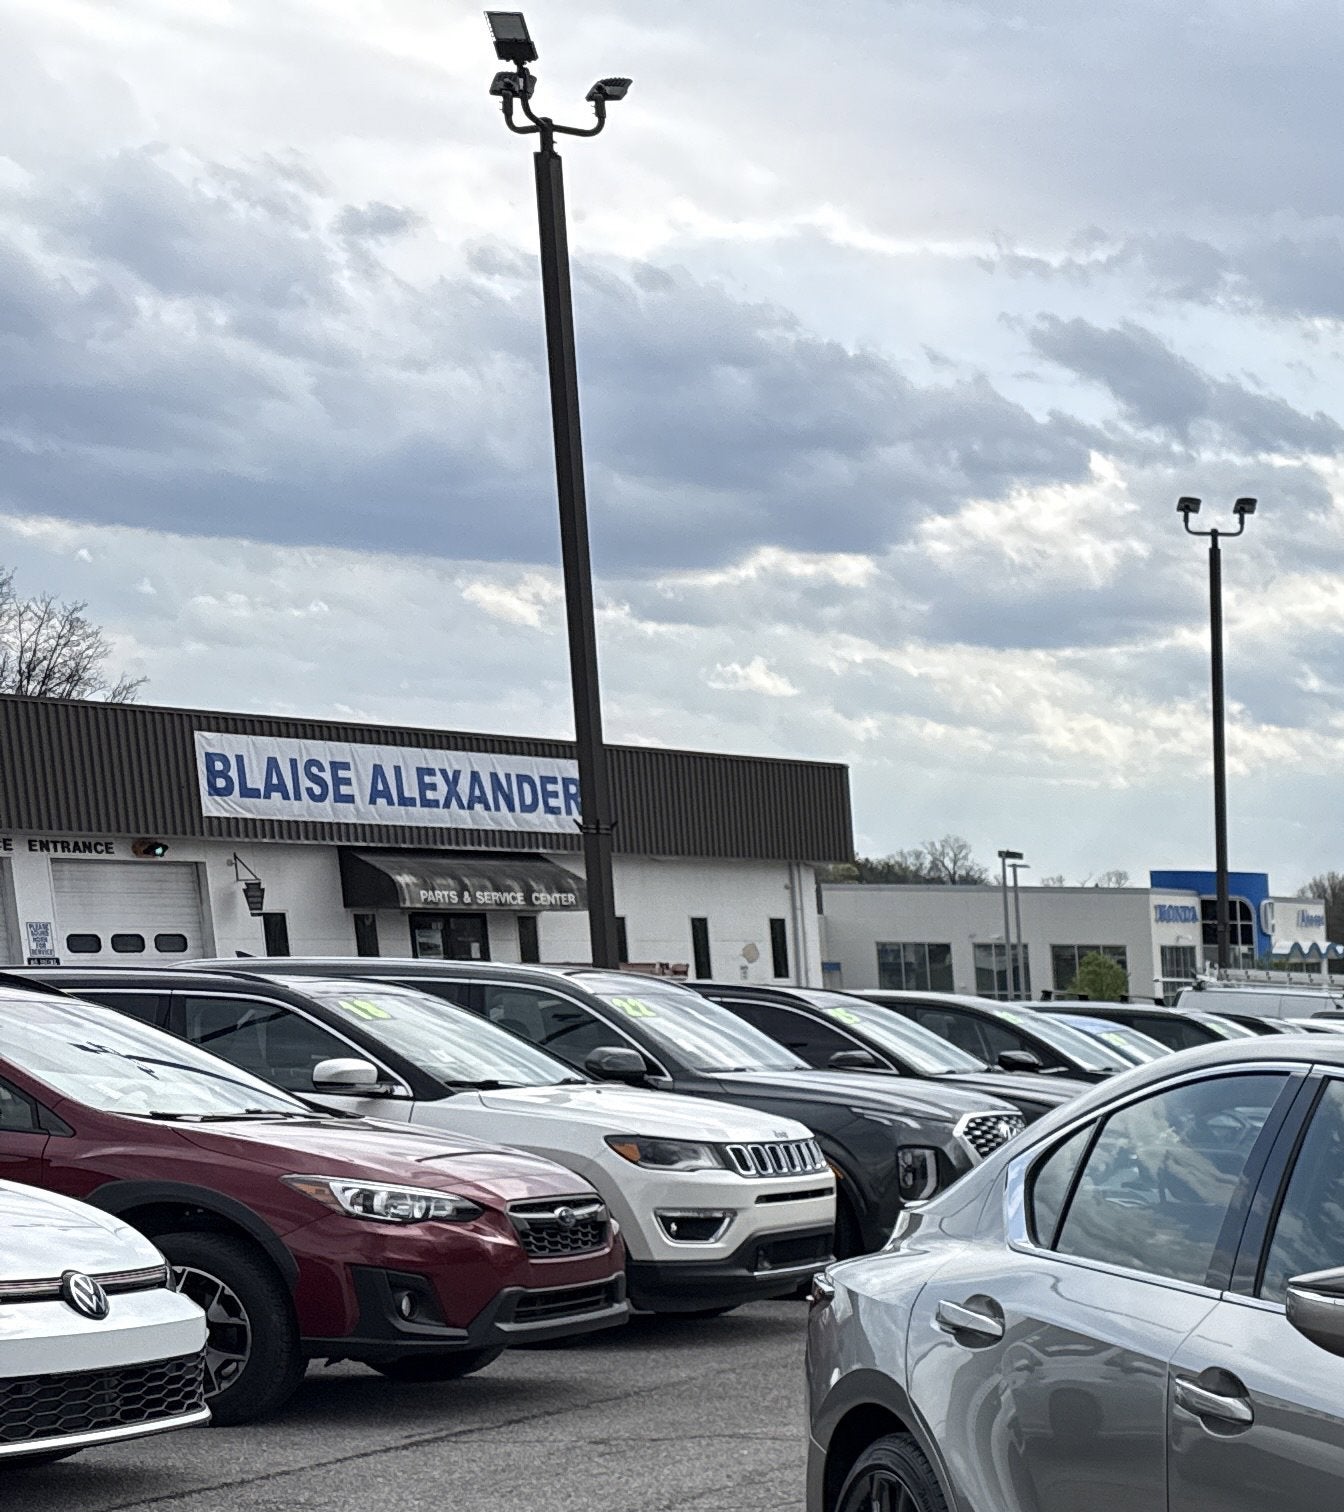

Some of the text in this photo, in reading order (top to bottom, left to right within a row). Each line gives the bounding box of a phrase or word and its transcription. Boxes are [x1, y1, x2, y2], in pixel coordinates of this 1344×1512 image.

[204, 751, 583, 818] BLAISE ALEXANDER
[27, 839, 115, 855] ENTRANCE
[420, 890, 577, 906] PARTS & SERVICE CENTER
